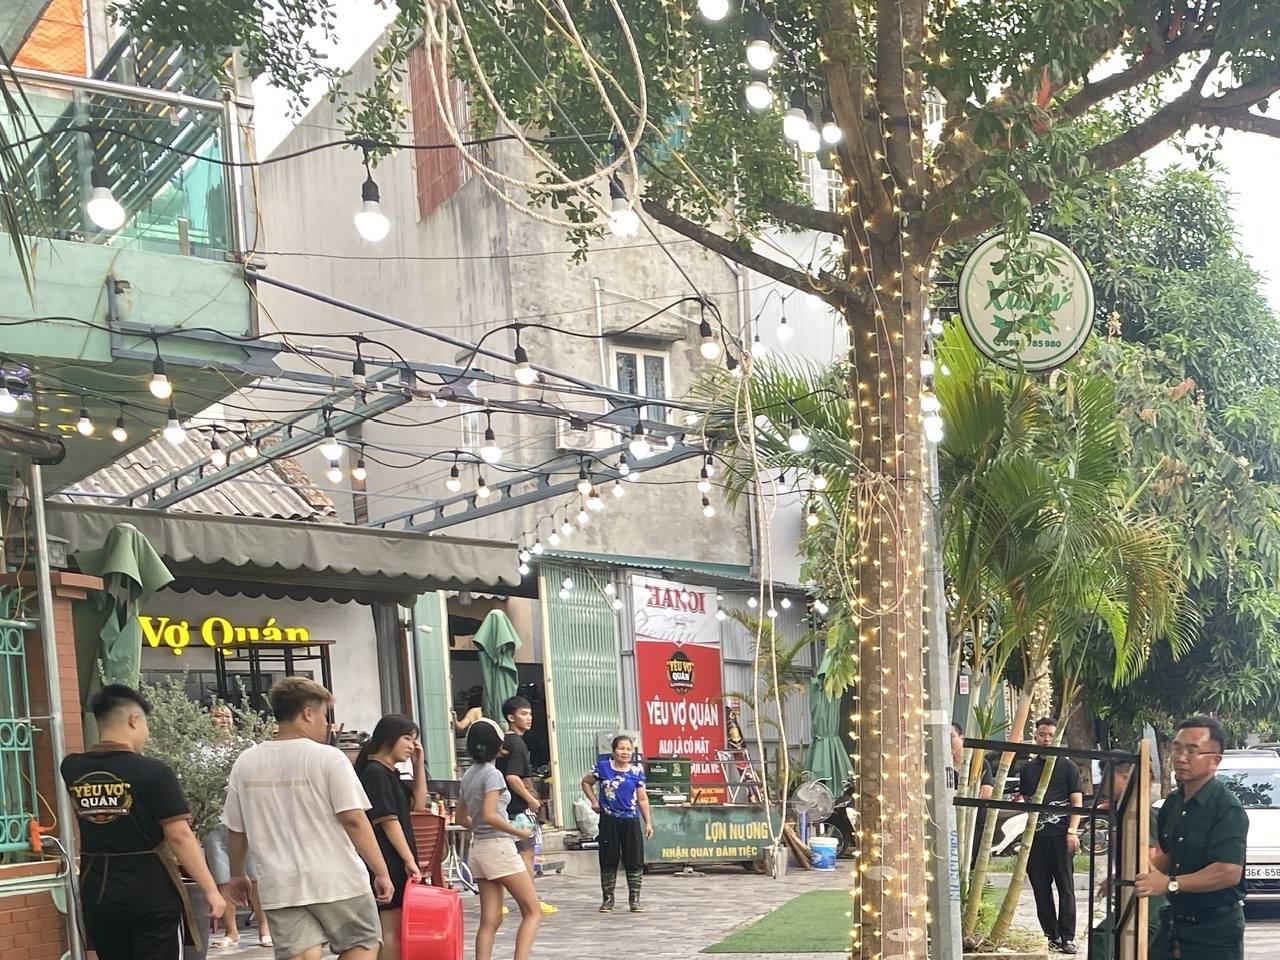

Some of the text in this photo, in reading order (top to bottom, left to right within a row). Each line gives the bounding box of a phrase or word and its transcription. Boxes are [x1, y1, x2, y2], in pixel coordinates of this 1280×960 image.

[137, 616, 190, 655] Vợ
[646, 694, 719, 732] YÊU VỢ QUÁN
[659, 736, 710, 757] ALO LÀ CÓ MẶT
[80, 796, 118, 808] QUÁN
[705, 821, 726, 843] LỢN
[690, 847, 714, 857] QUAY
